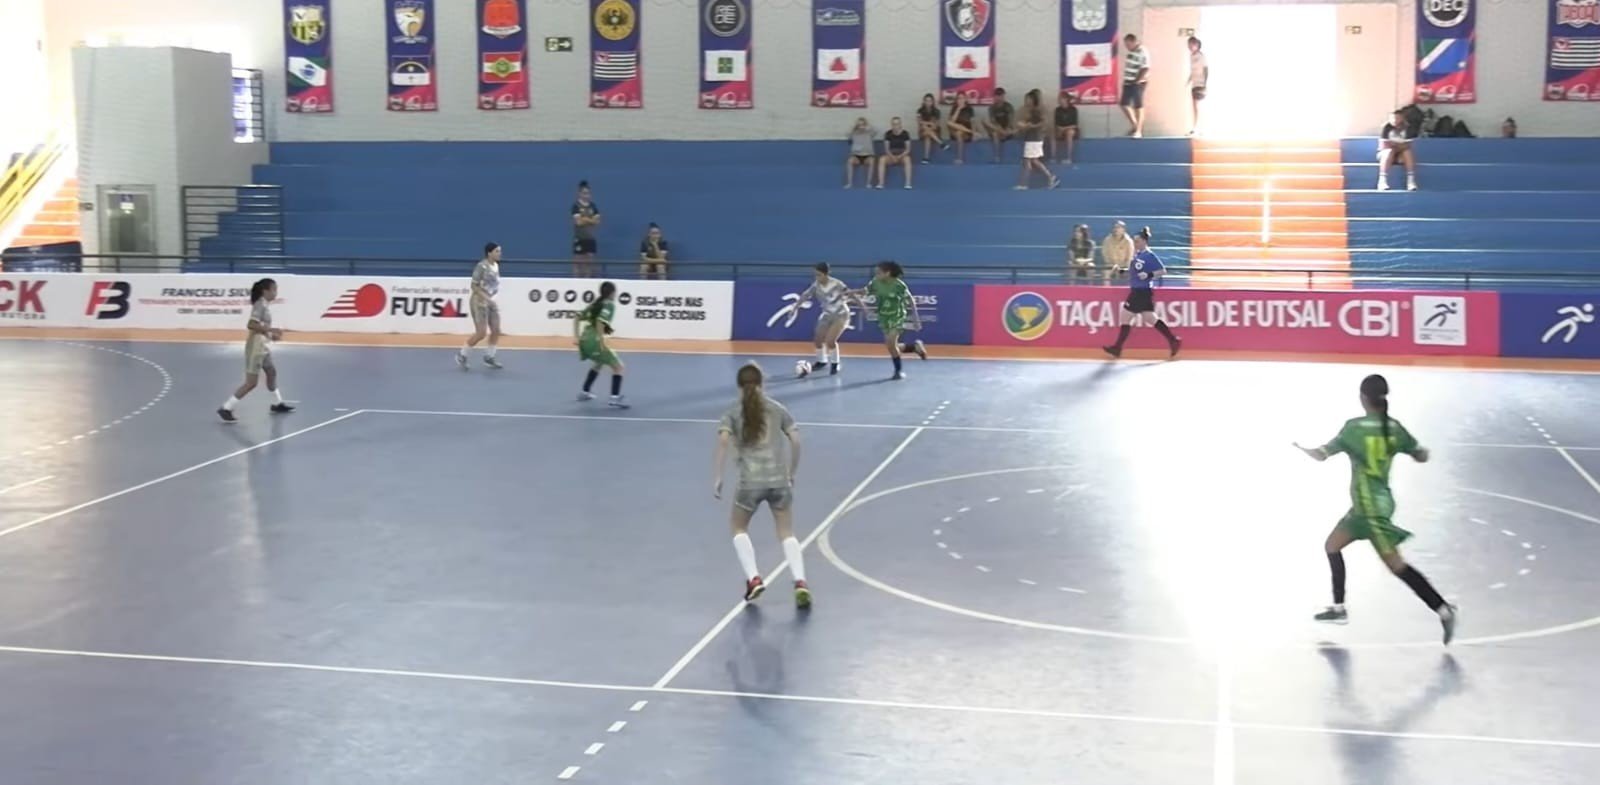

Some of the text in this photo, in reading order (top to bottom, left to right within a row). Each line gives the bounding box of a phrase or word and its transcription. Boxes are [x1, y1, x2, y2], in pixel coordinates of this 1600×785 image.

[227, 287, 252, 297] SILV
[1057, 300, 1114, 334] TAÇA
[1119, 300, 1203, 328] ASIL
[1207, 300, 1239, 327] DE
[1243, 300, 1331, 327] FUTSAL
